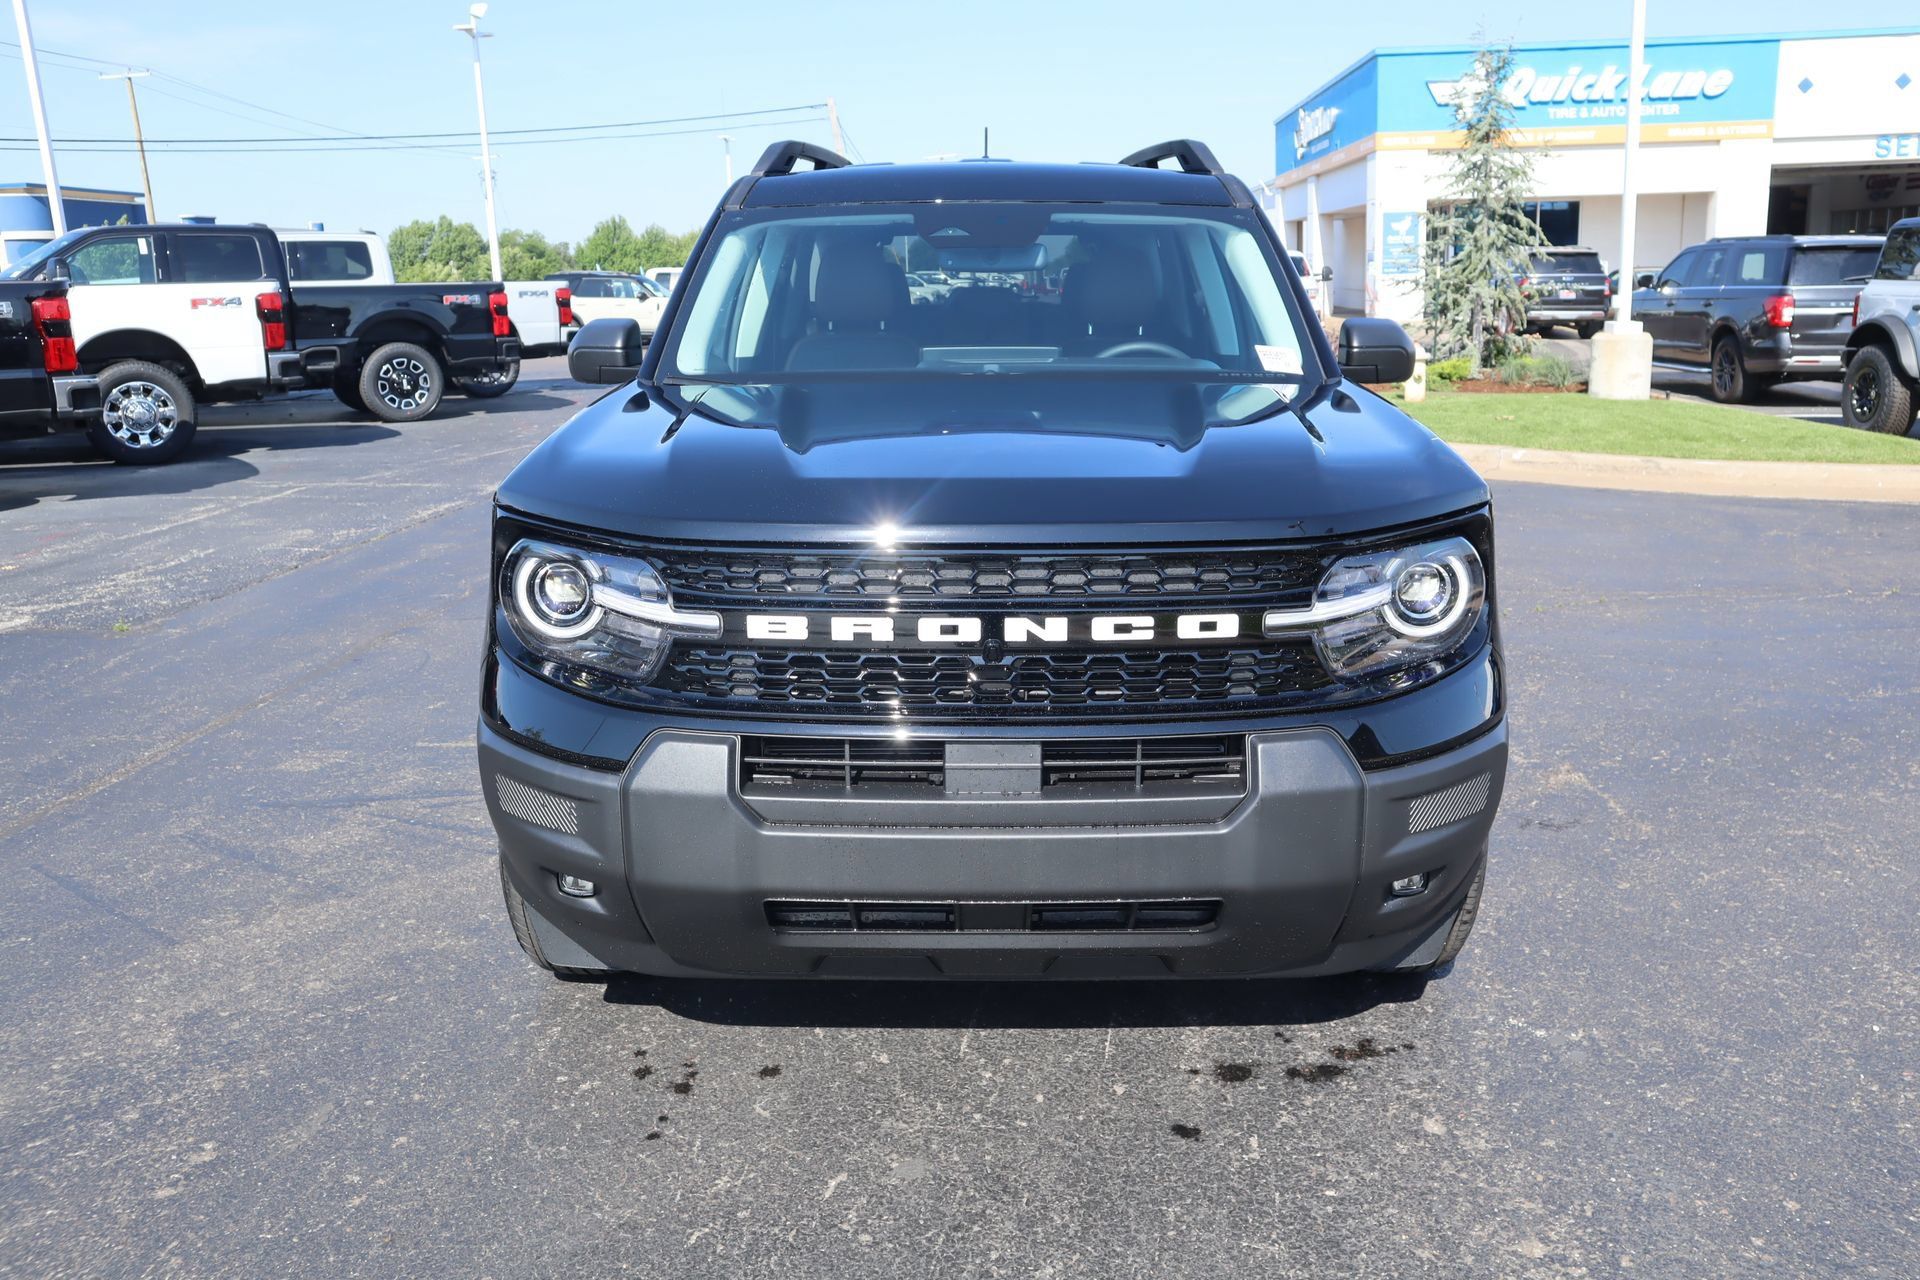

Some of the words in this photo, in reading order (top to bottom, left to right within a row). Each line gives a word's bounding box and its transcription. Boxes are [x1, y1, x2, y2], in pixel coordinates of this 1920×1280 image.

[1502, 65, 1628, 109] Quick
[1548, 106, 1577, 119] TIRE
[1579, 105, 1589, 118] &
[1637, 103, 1681, 116] ENTER
[442, 294, 481, 305] FX4
[519, 290, 549, 298] FX4
[190, 297, 243, 310] FX4
[745, 614, 1241, 642] BRONCO
